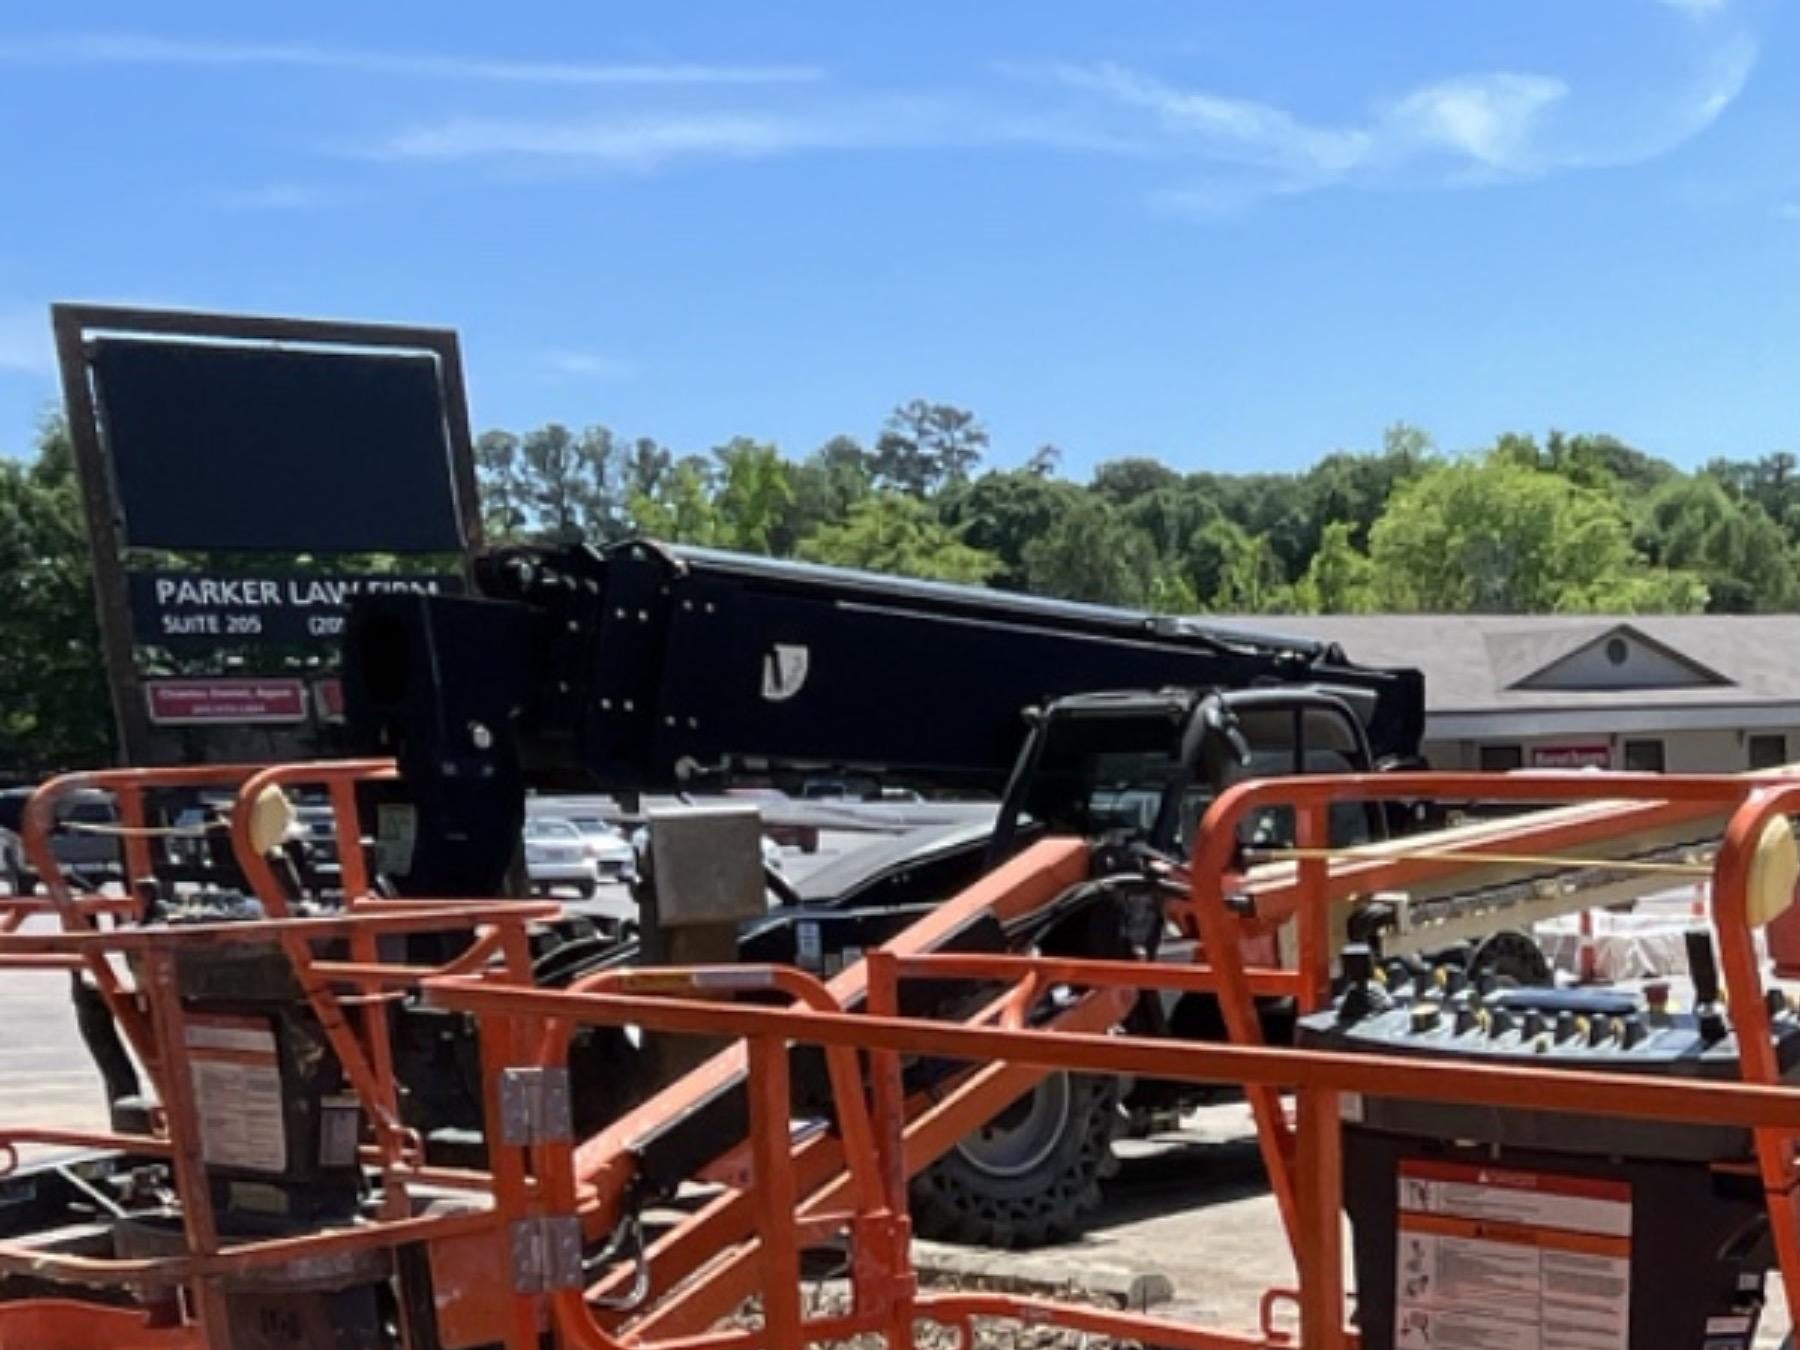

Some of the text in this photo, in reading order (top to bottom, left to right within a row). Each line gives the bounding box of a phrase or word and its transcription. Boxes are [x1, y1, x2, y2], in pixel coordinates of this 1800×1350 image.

[155, 578, 282, 605] PARKER
[287, 580, 359, 605] LAW
[161, 614, 221, 634] SUITE
[226, 614, 262, 635] 205
